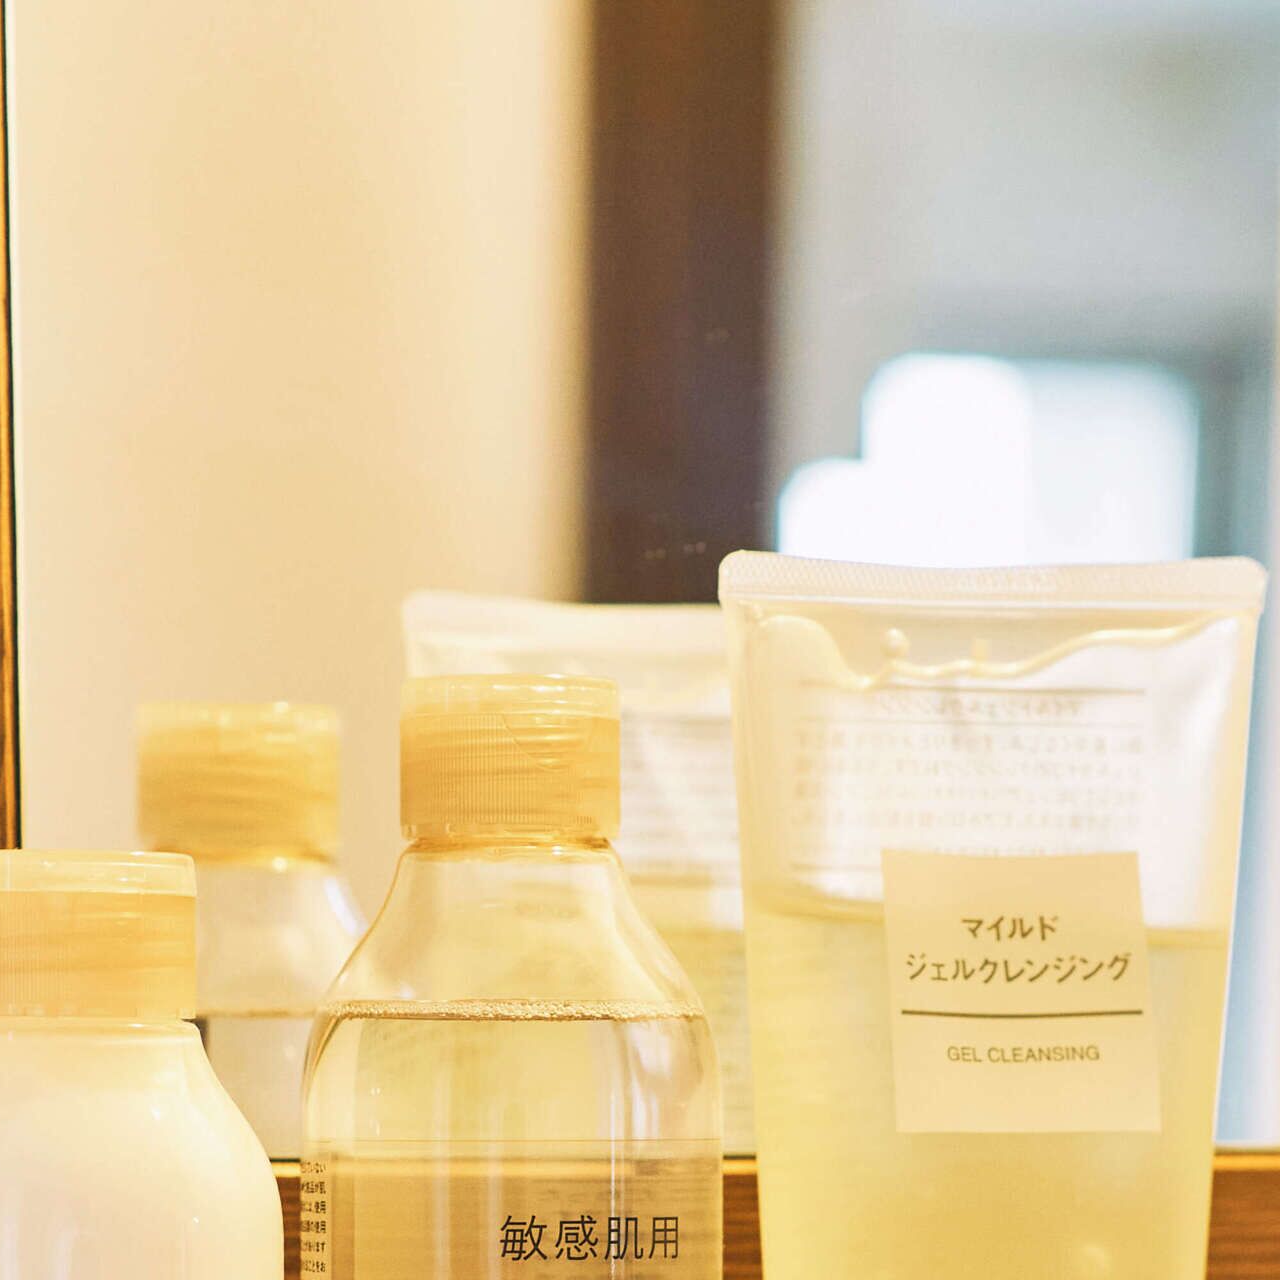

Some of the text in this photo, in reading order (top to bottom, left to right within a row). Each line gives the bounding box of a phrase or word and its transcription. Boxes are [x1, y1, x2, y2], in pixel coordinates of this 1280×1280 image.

[961, 915, 1059, 942] マイルド
[906, 952, 1131, 984] ジェルクレンジング
[947, 1045, 1100, 1064] GEL CLEANSING
[499, 1214, 679, 1262] 敏感肌用
